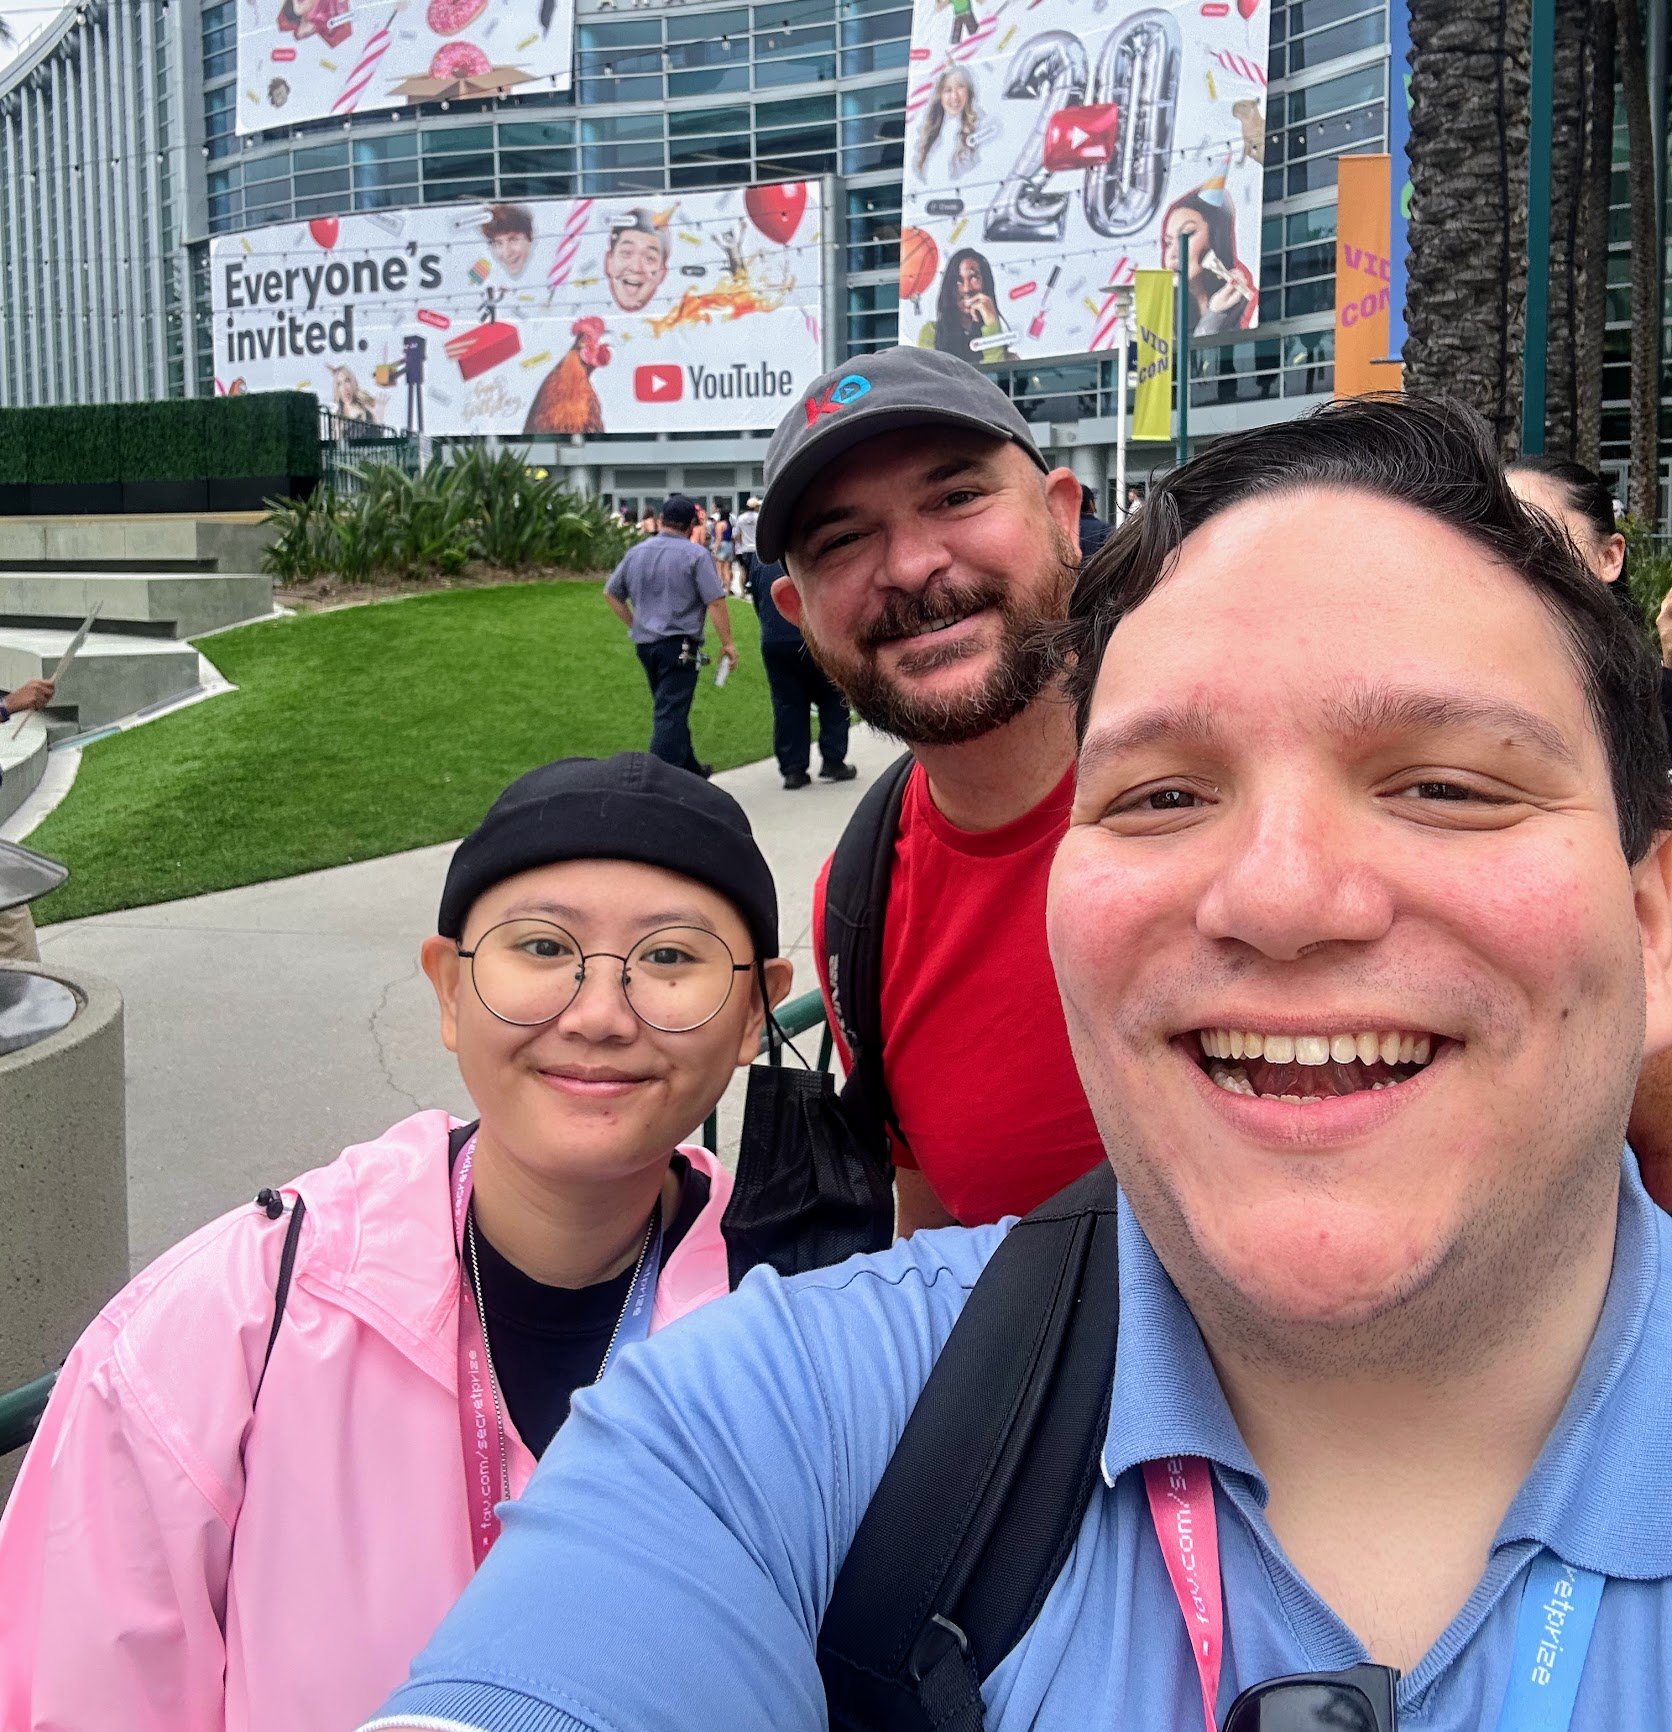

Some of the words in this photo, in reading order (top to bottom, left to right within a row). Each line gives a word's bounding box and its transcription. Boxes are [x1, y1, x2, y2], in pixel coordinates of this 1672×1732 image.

[982, 8, 1182, 242] 20
[225, 241, 443, 311] Everyone's
[227, 305, 369, 363] invited.
[1140, 324, 1169, 355] VID
[688, 361, 793, 400] YouTube
[1138, 356, 1169, 384] CON
[468, 1350, 492, 1530] fav.com/secretprize
